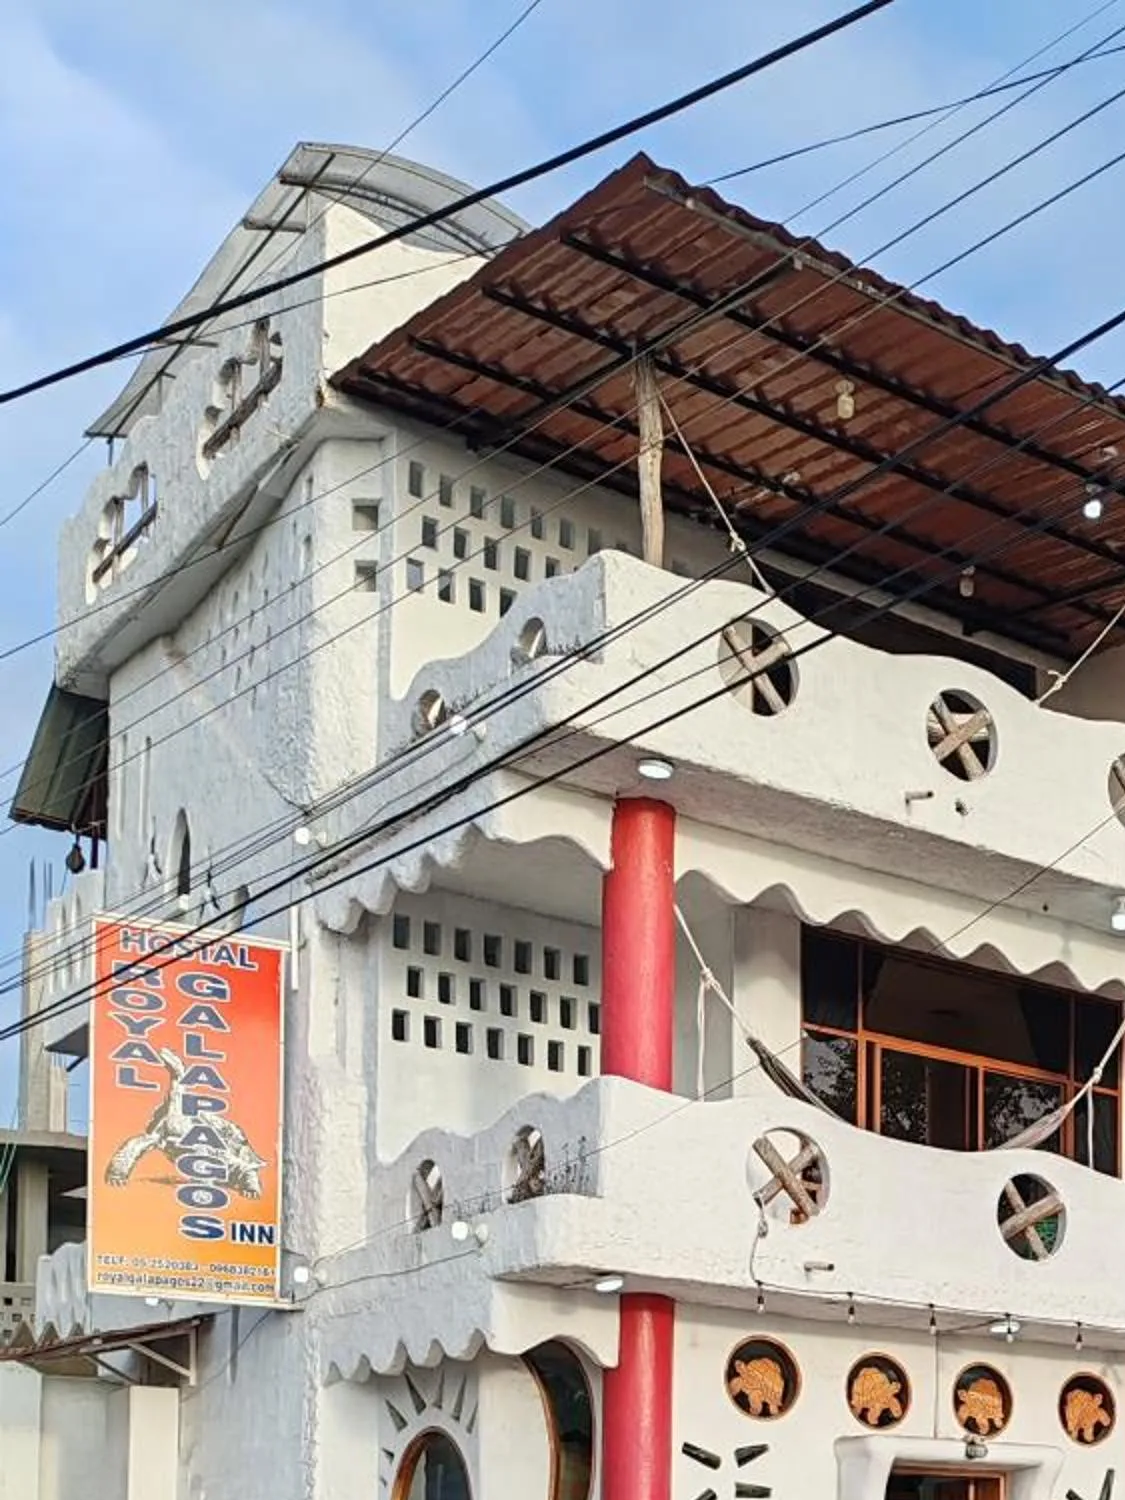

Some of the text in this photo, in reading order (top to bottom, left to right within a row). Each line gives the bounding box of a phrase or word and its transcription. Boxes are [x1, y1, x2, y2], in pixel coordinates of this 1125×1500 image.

[120, 928, 258, 970] HOSTAL
[108, 960, 167, 1090] ROYAL
[176, 972, 230, 1239] GALAPAGOS
[230, 1222, 275, 1245] INN
